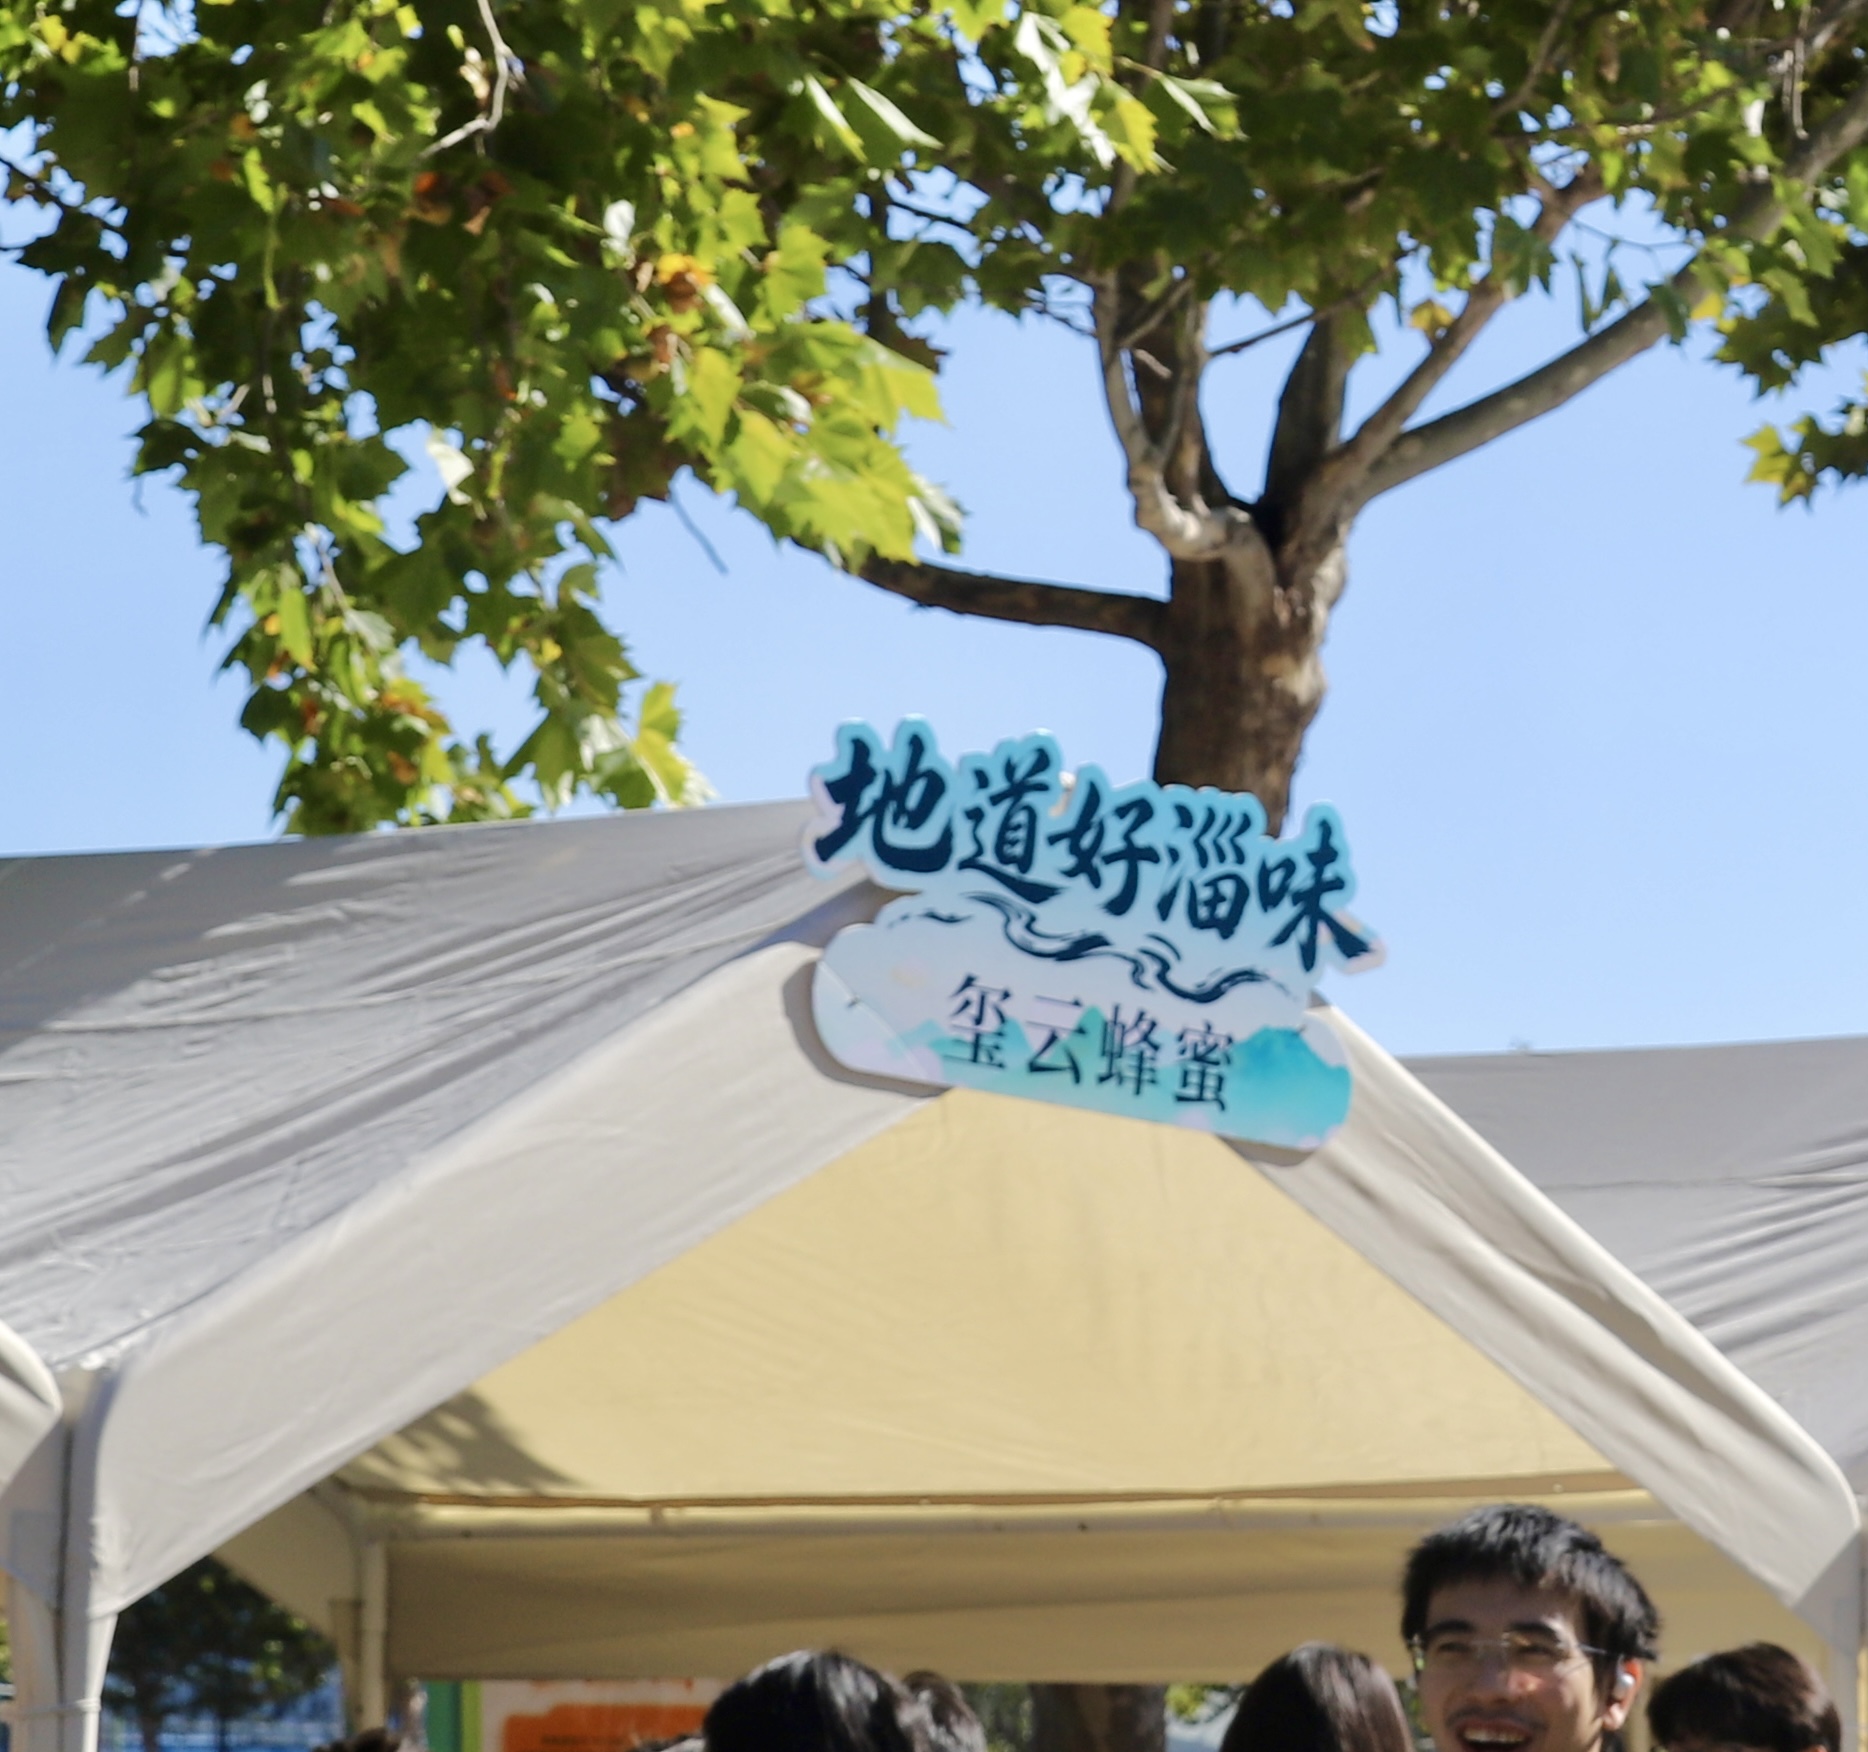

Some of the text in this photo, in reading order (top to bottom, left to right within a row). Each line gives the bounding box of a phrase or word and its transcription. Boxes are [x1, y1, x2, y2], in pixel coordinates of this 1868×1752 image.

[815, 733, 1373, 972] 地道好淄味
[944, 973, 1236, 1112] 玺云蜂蜜
